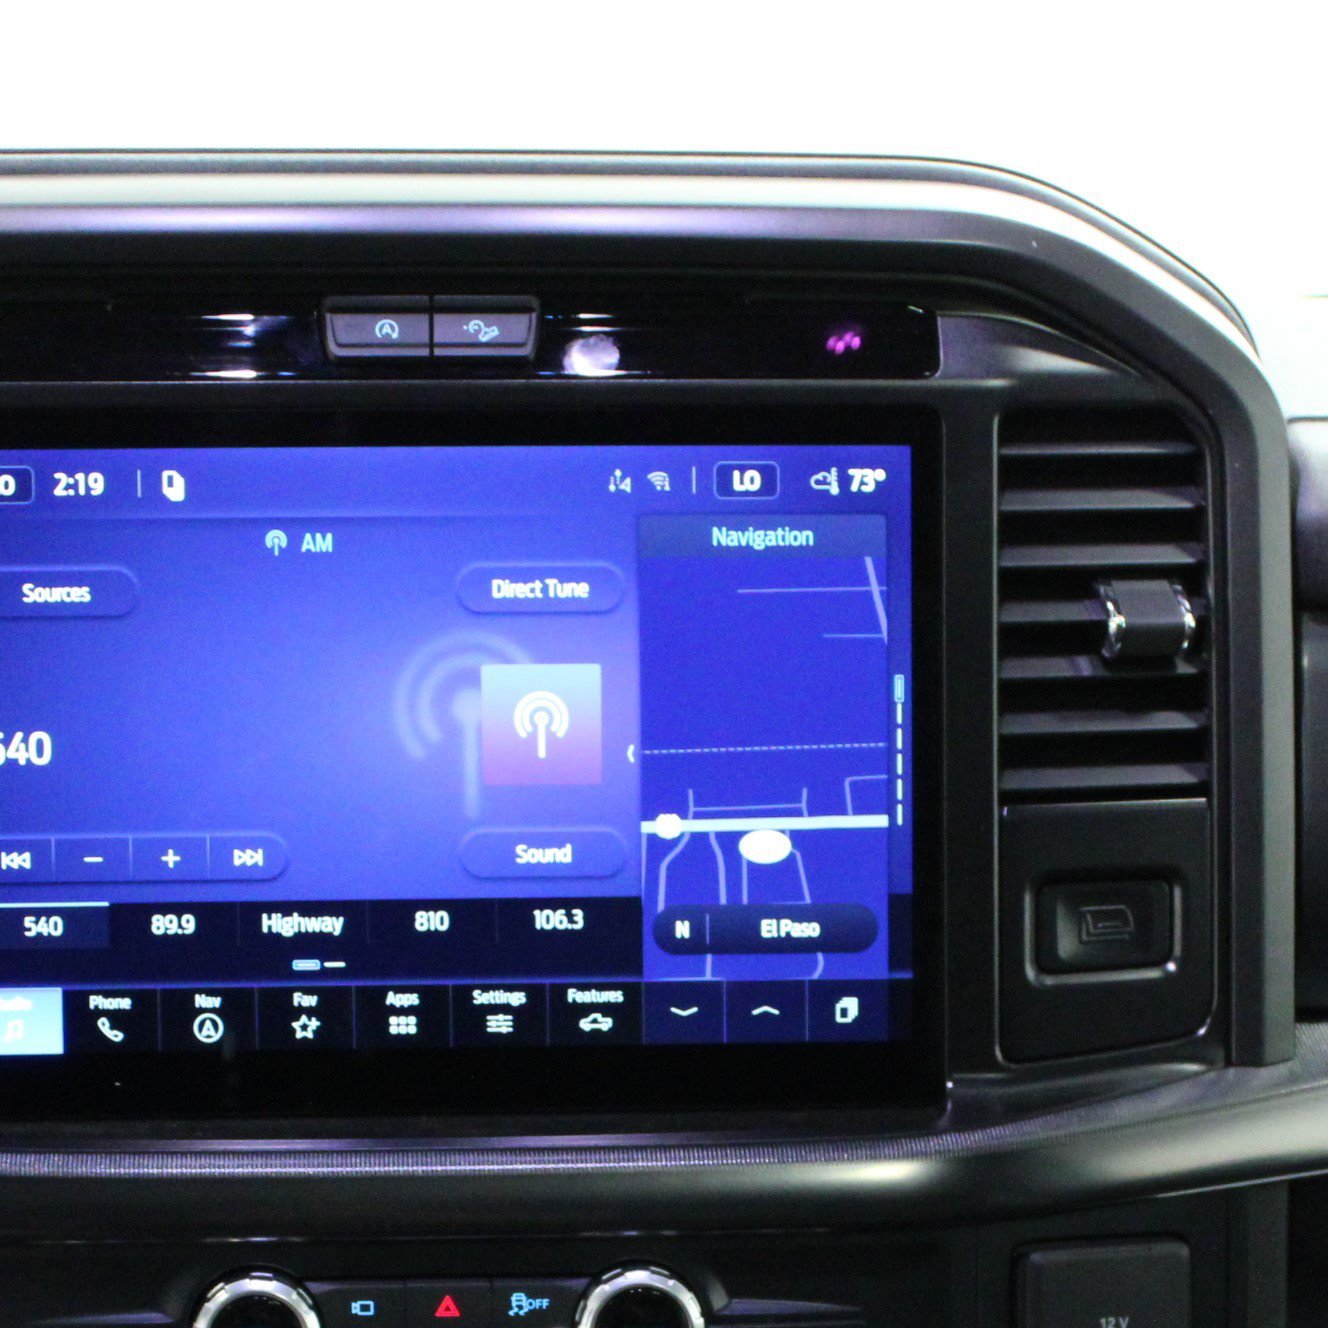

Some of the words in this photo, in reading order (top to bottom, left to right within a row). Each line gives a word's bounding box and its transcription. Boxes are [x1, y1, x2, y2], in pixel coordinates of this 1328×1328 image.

[52, 471, 105, 497] 2:19
[732, 469, 762, 492] LO
[300, 532, 333, 553] AM
[712, 526, 814, 551] Navigation
[21, 582, 92, 603] Sources
[491, 578, 544, 599] Direct
[544, 577, 590, 599] Tune
[515, 843, 573, 864] Sound
[23, 915, 64, 937] 540
[150, 913, 196, 936] 89.9
[261, 911, 345, 937] Highway
[414, 910, 450, 932] 810
[532, 908, 584, 930] 106.3
[674, 919, 690, 939] N
[760, 918, 779, 938] El
[779, 918, 821, 938] Paso
[88, 994, 132, 1010] Phone
[194, 993, 222, 1009] Nav
[292, 991, 318, 1008] Fav
[385, 990, 420, 1008] Apps
[472, 989, 527, 1007] Settings
[567, 987, 624, 1004] Features
